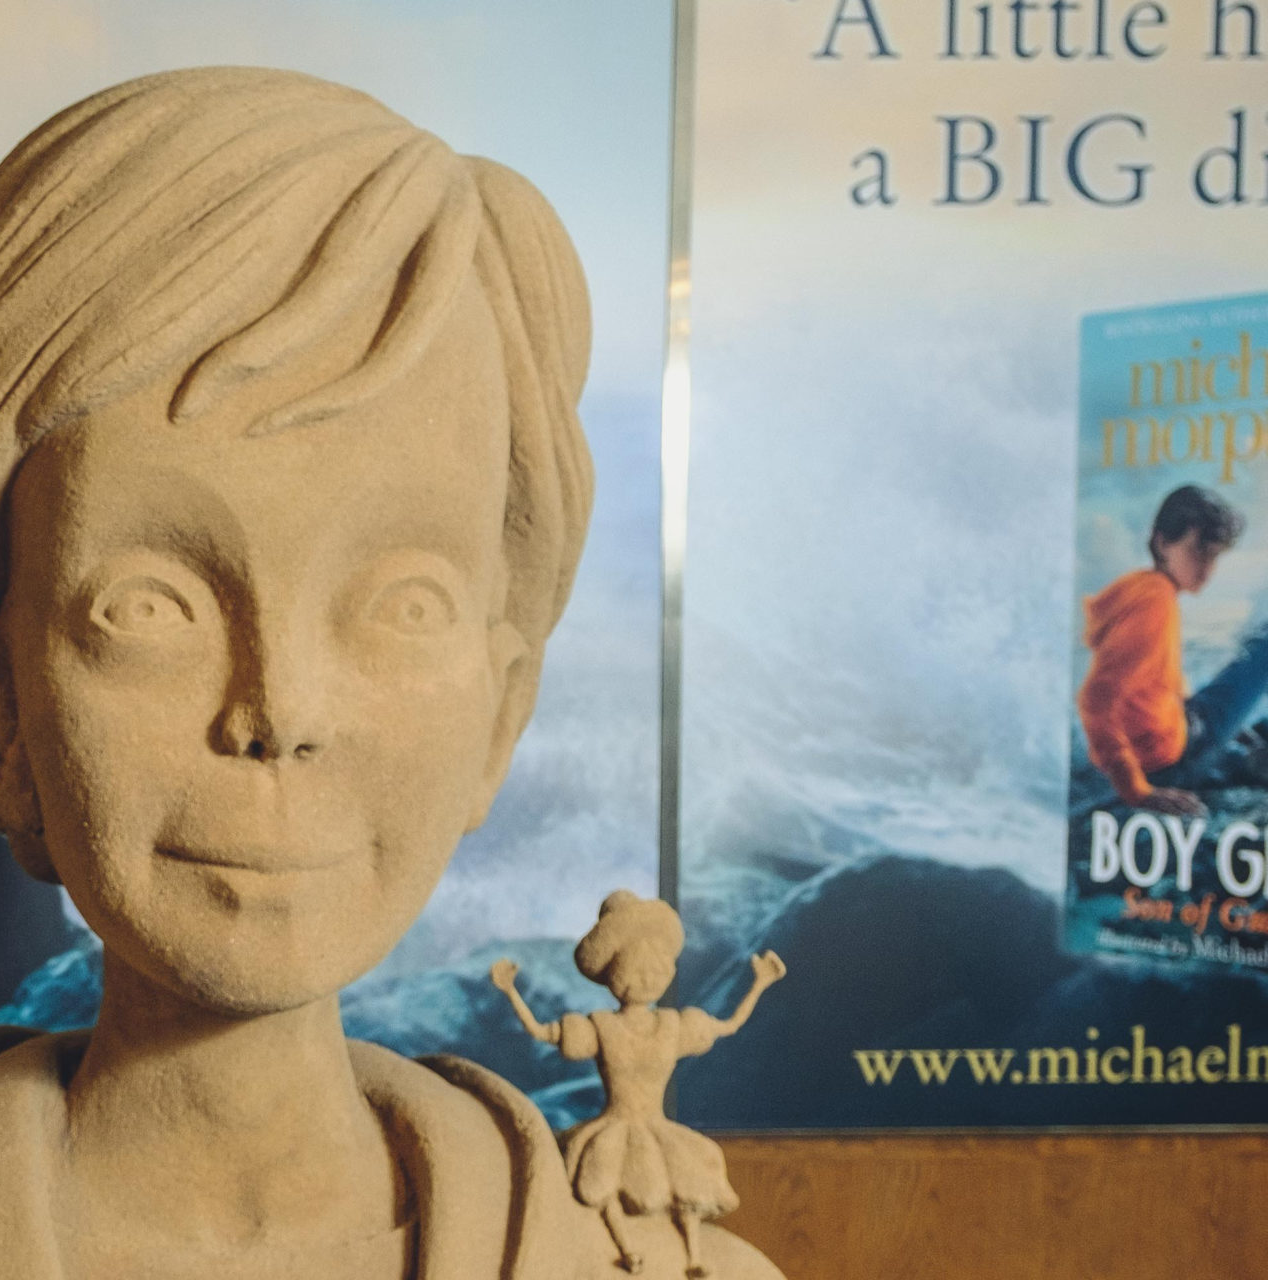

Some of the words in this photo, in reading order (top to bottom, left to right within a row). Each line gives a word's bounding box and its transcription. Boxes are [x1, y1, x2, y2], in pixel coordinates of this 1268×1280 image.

[939, 0, 1169, 60] little
[850, 148, 898, 207] a
[934, 113, 1154, 207] BIG
[1100, 408, 1268, 484] morp
[1089, 809, 1207, 891] BOY
[1215, 820, 1268, 899] G
[1180, 892, 1217, 935] of
